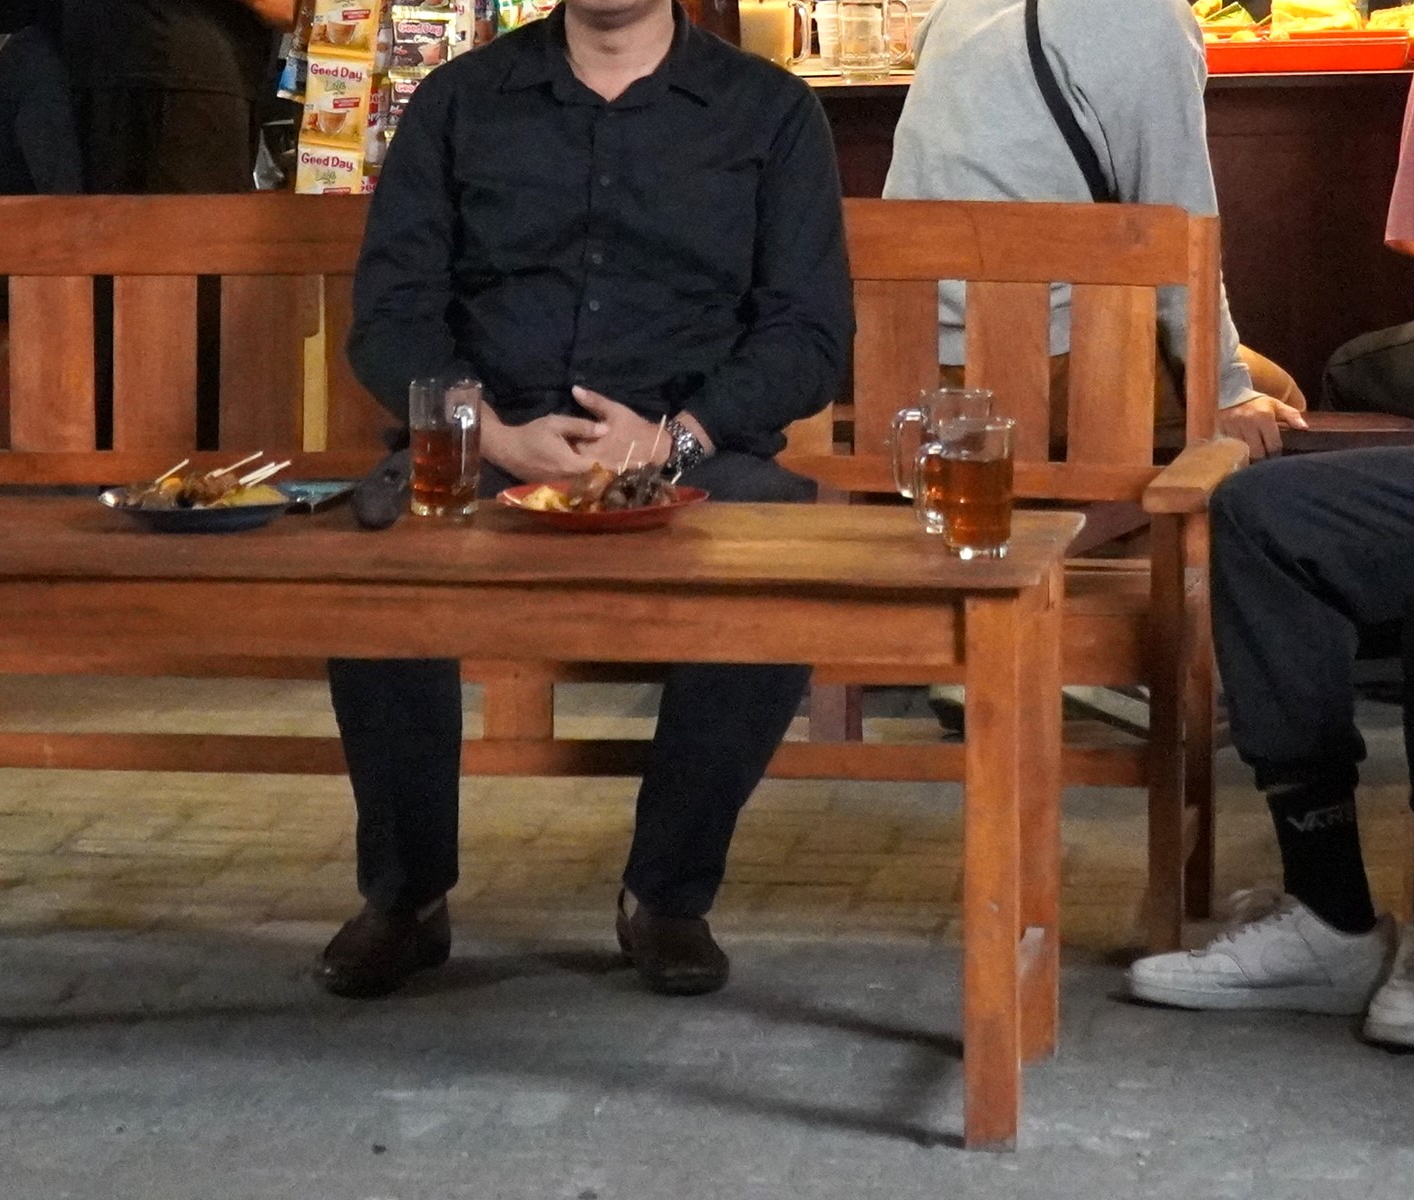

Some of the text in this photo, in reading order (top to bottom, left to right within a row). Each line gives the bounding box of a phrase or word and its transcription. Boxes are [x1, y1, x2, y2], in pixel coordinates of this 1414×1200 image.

[310, 63, 364, 82] Good Day
[301, 152, 355, 172] Good Day
